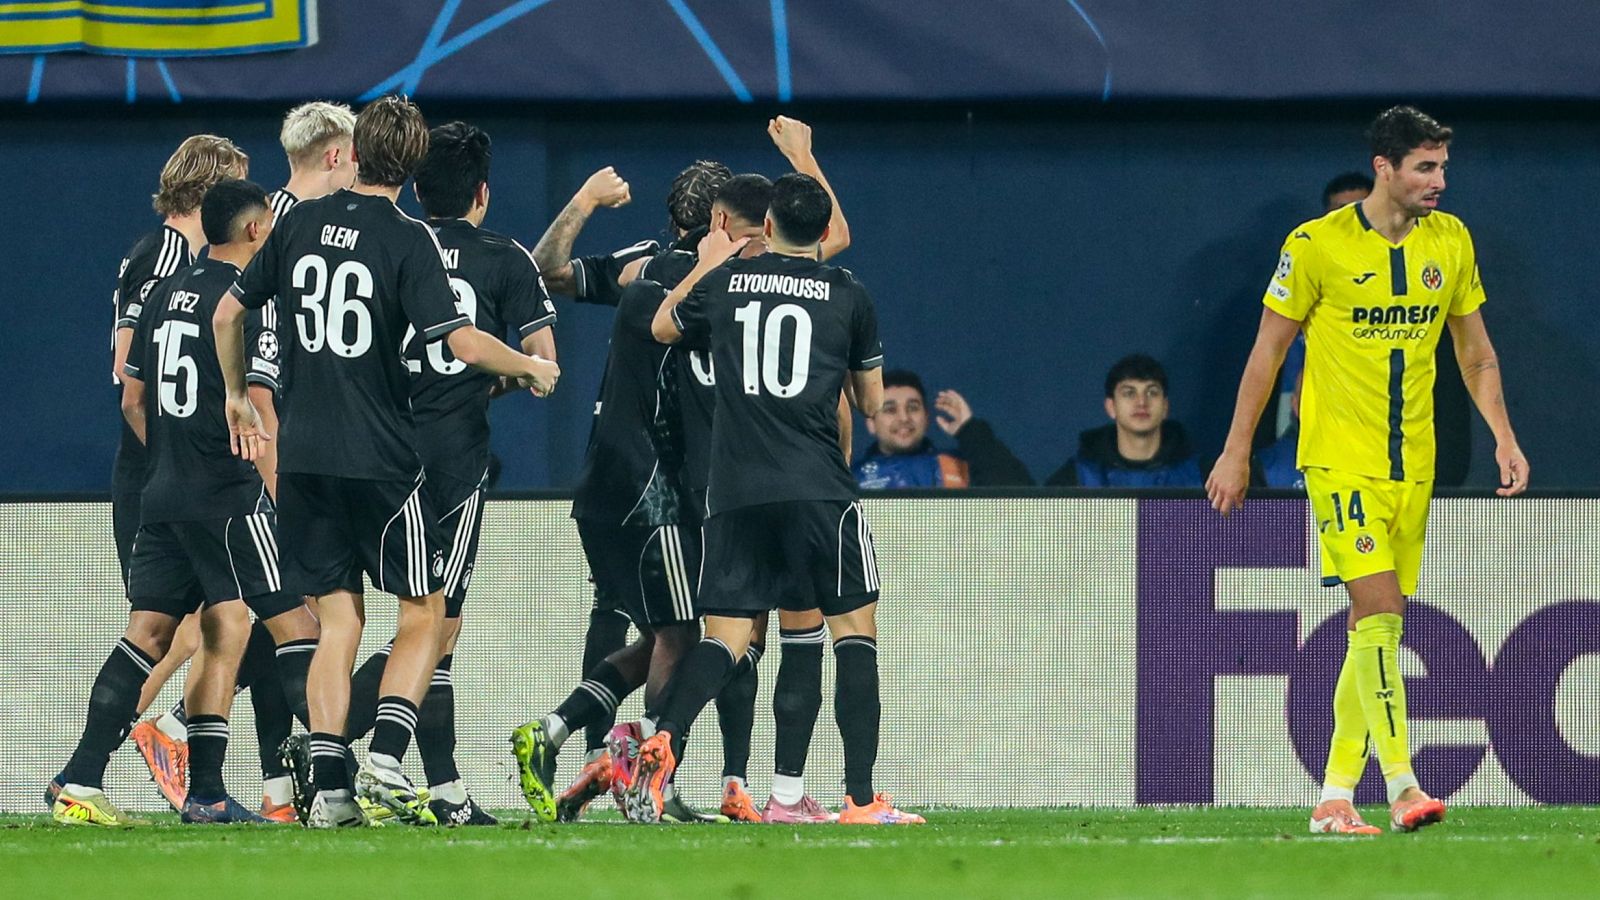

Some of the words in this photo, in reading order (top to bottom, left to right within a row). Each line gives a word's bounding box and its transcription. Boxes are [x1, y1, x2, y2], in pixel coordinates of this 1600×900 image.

[320, 224, 360, 251] CLEM
[292, 254, 374, 358] 36
[727, 273, 831, 301] ELYOUNOUSSI
[1352, 304, 1440, 325] PAMESA
[152, 319, 200, 418] 15
[734, 300, 813, 399] 10
[1331, 490, 1365, 532] 14
